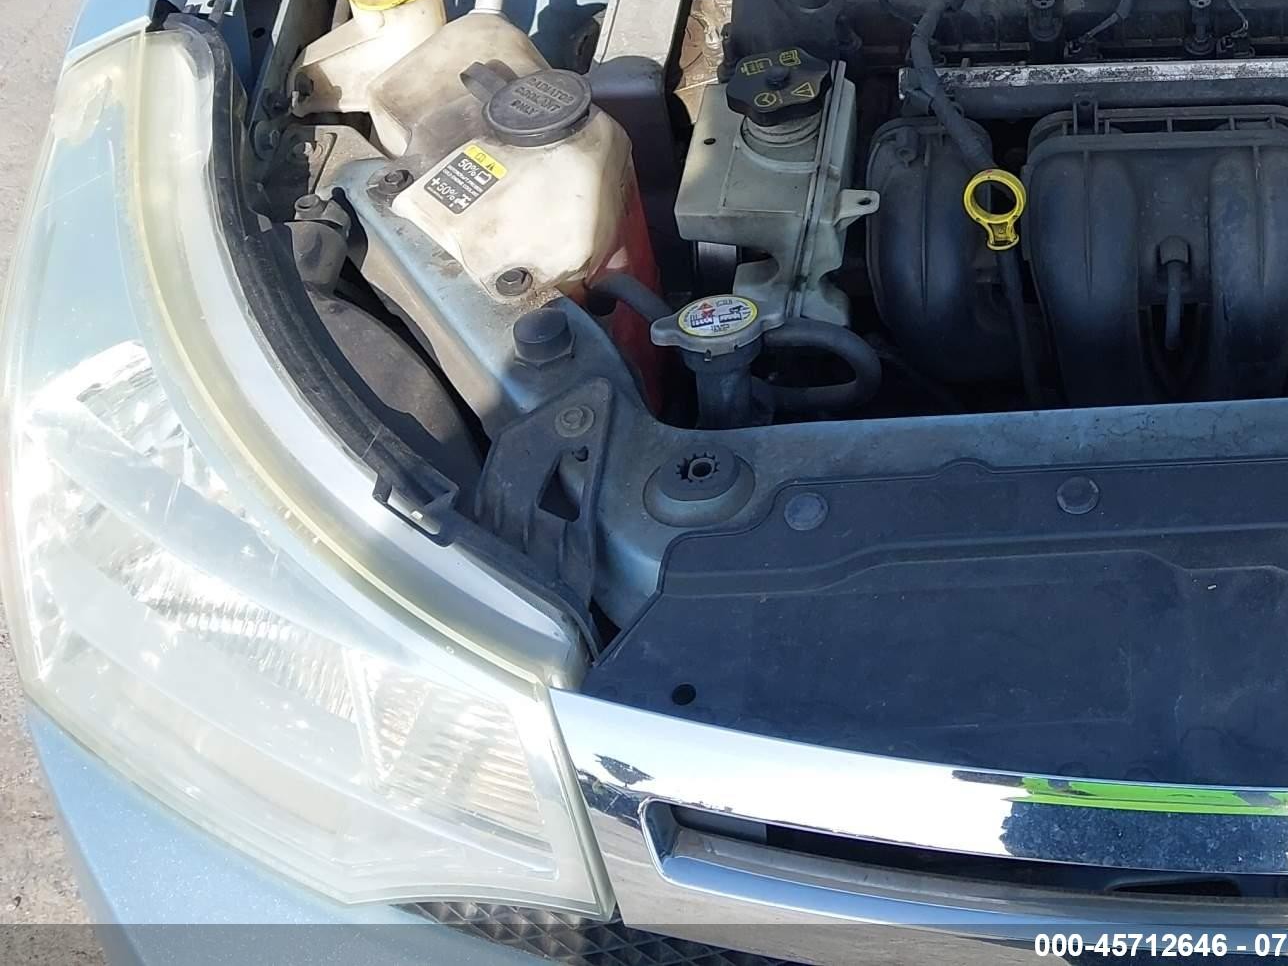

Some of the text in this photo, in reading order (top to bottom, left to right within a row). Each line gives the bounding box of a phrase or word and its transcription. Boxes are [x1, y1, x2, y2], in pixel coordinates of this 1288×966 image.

[513, 86, 561, 112] COOLANT
[526, 77, 575, 103] RADIATOR
[510, 99, 540, 115] ONLY
[458, 158, 480, 177] 50%
